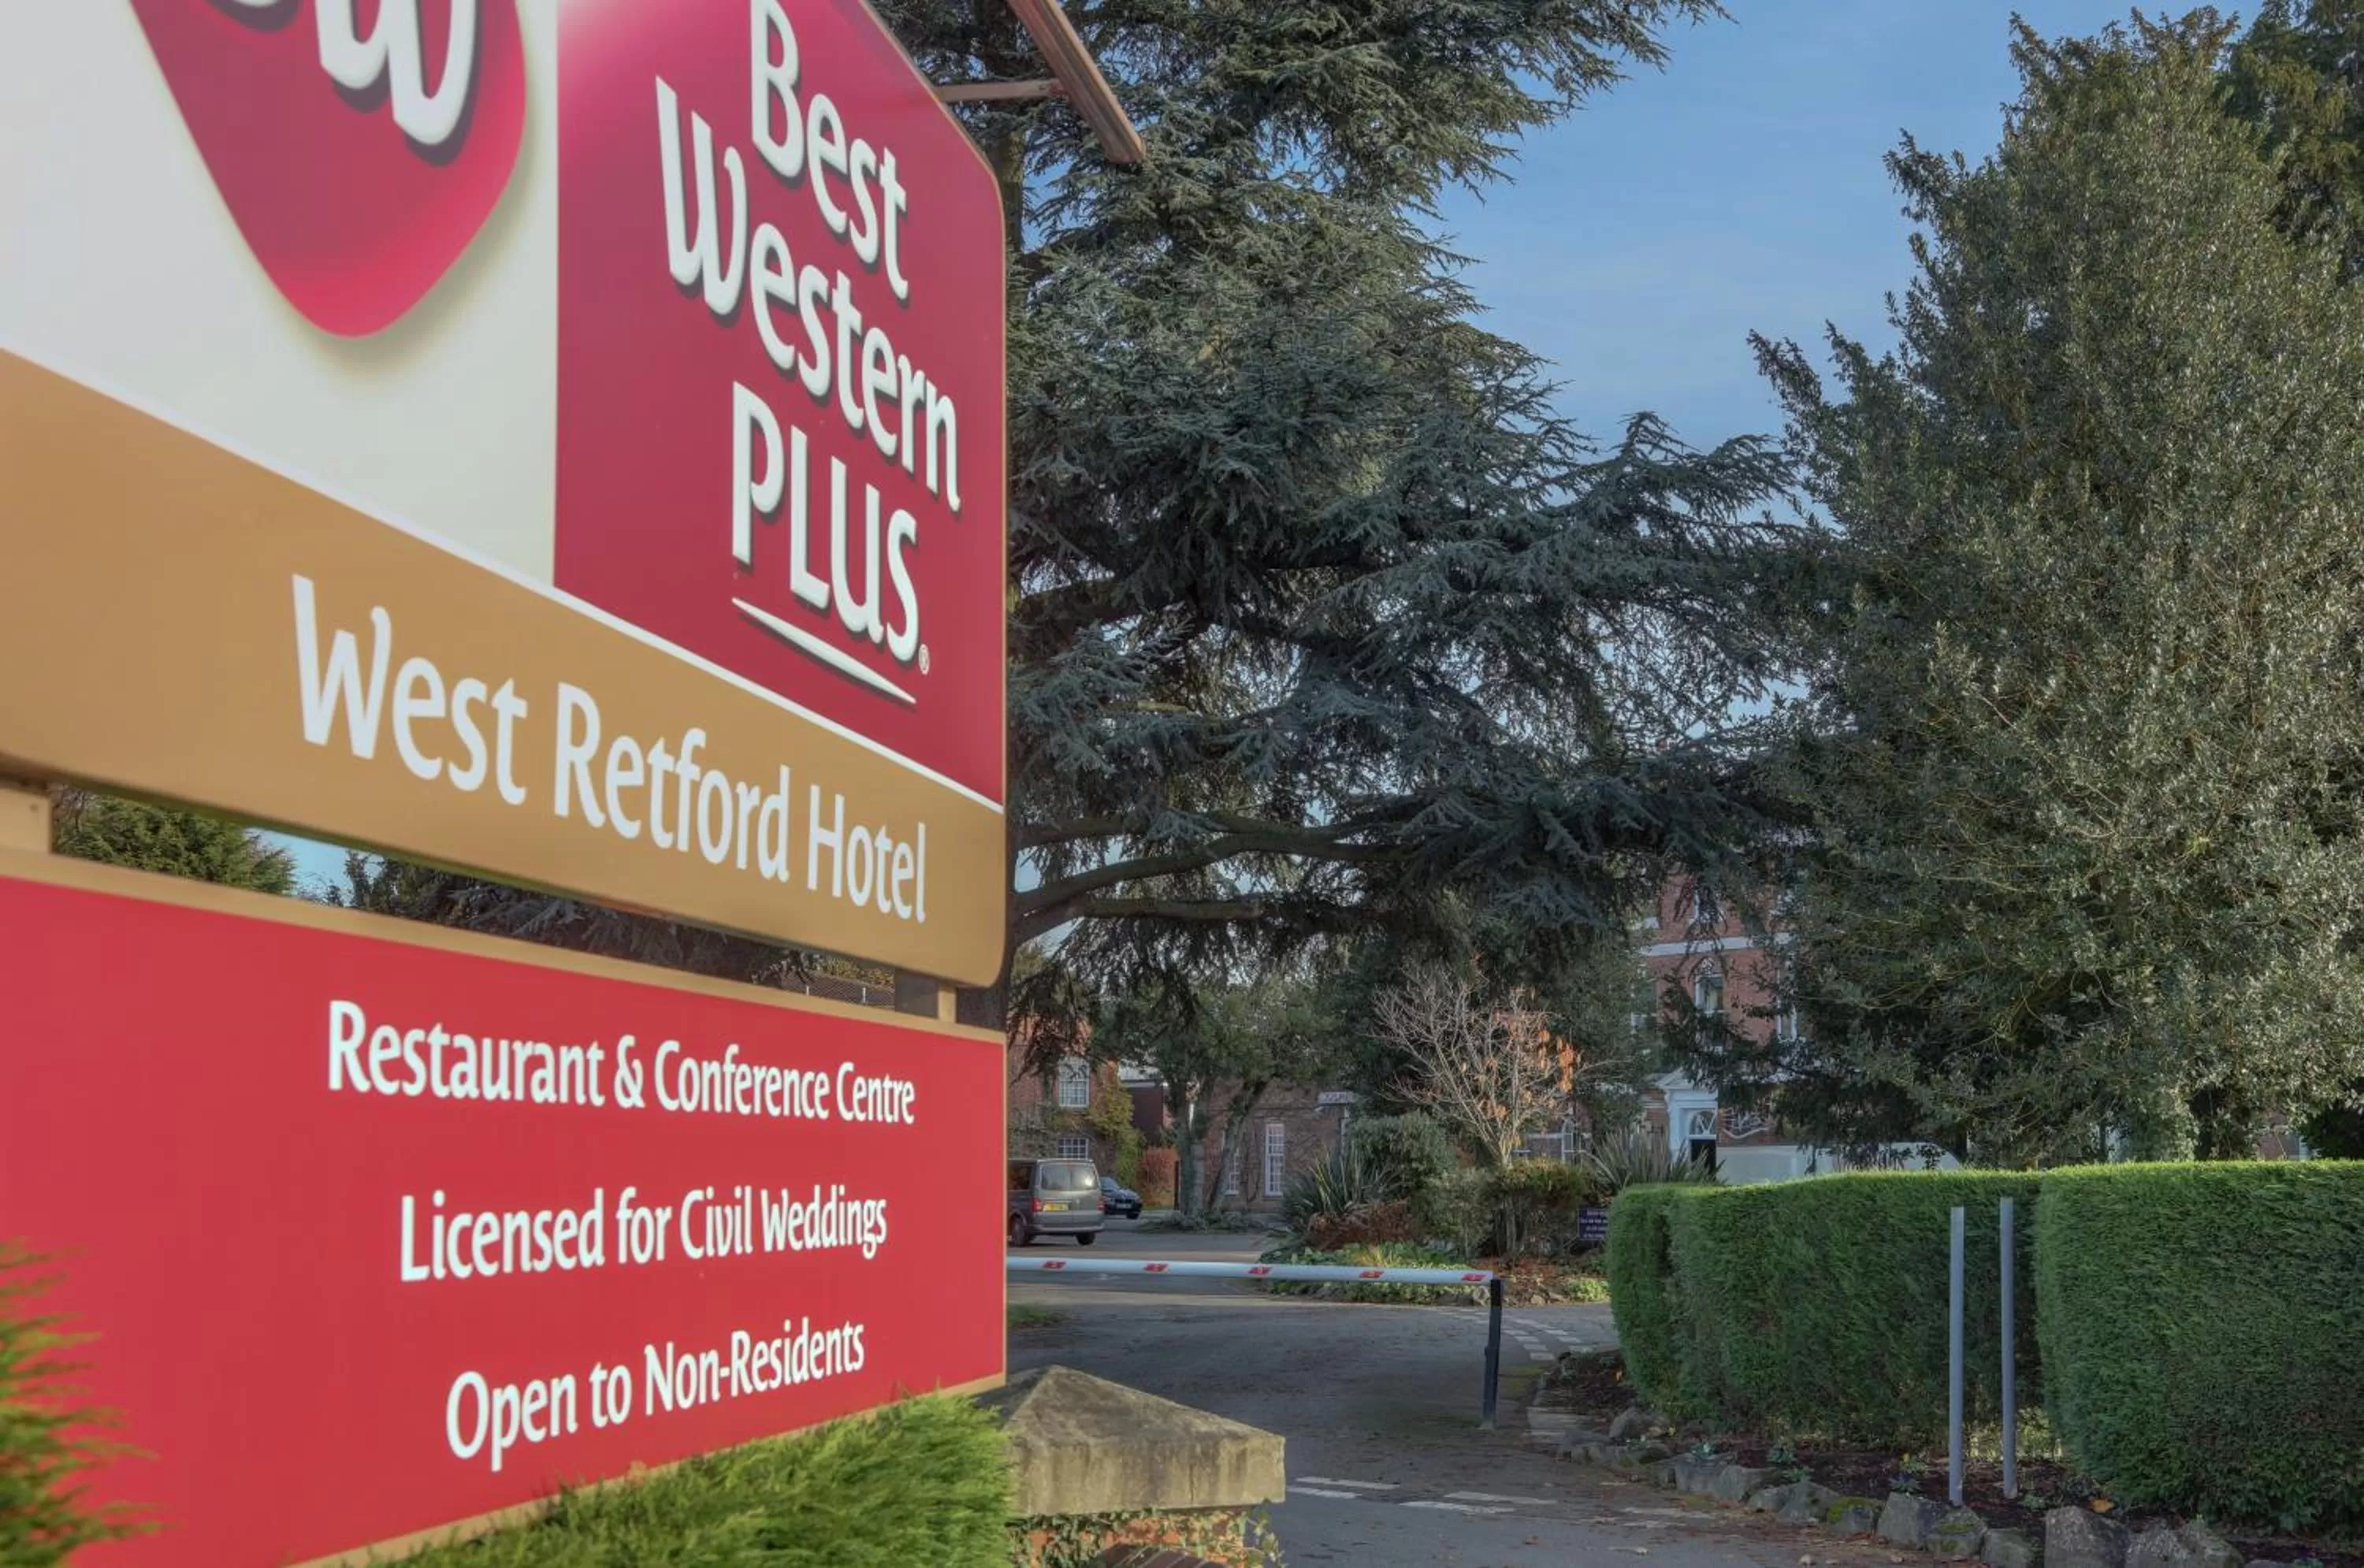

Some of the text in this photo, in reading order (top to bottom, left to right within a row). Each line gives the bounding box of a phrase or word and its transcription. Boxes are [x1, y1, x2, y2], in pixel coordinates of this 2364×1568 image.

[749, 0, 909, 300] Best
[655, 75, 961, 512] Western
[292, 574, 927, 925] West Retford Hotel
[328, 999, 916, 1125] Restaurant & Conference Centre
[400, 1183, 888, 1282] Licensed for Civil Weddings
[444, 1317, 865, 1472] Open to Non-Residents
